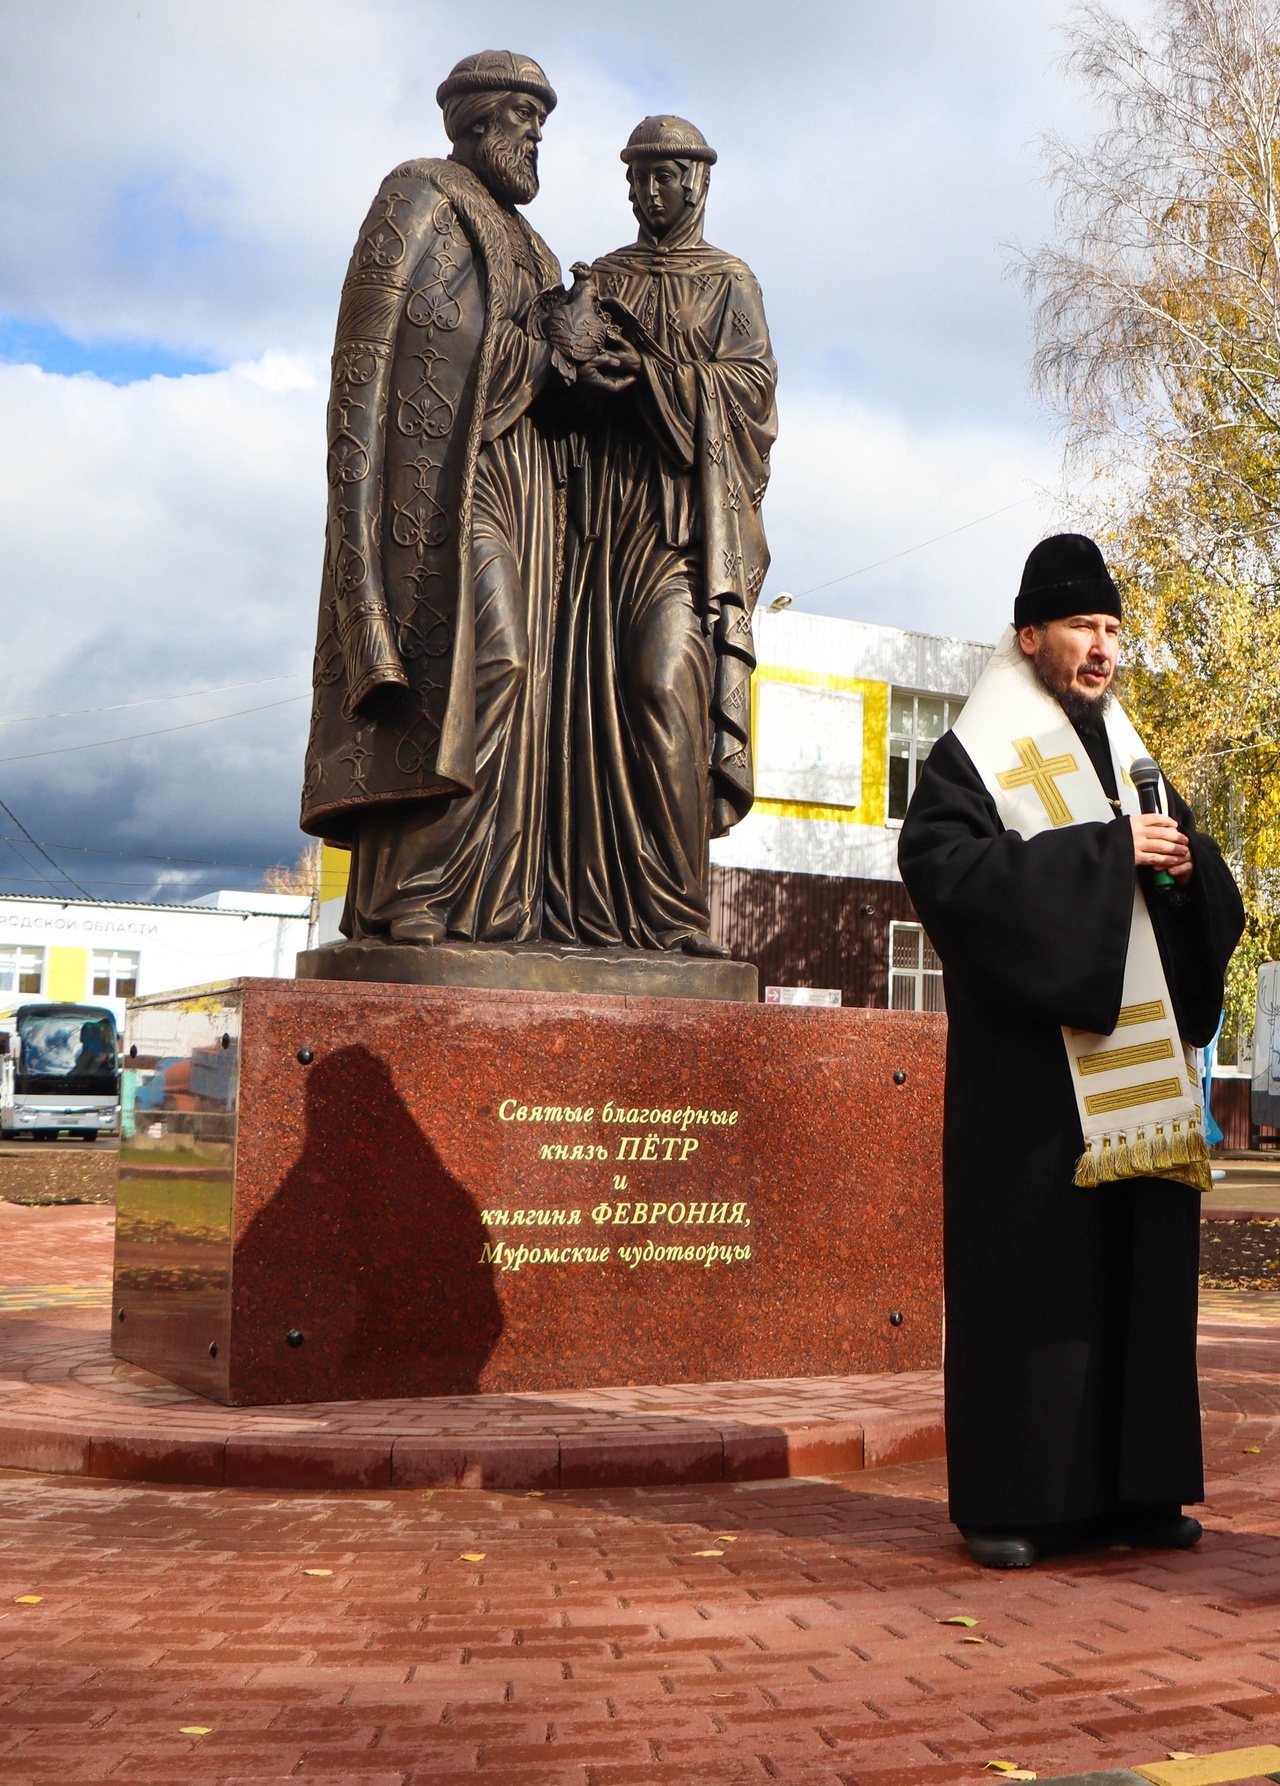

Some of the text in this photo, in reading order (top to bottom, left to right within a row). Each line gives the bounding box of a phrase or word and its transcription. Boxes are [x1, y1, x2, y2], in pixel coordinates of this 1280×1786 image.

[82, 919, 158, 934] ОБЛАСТИ
[498, 1099, 739, 1131] Святые благоверные
[540, 1133, 699, 1161] князь ПЁТР
[612, 1173, 628, 1190] и
[480, 1201, 751, 1228] княгиня ФЕВРОНИЯ,
[478, 1239, 751, 1271] Муромские чудотворцы
